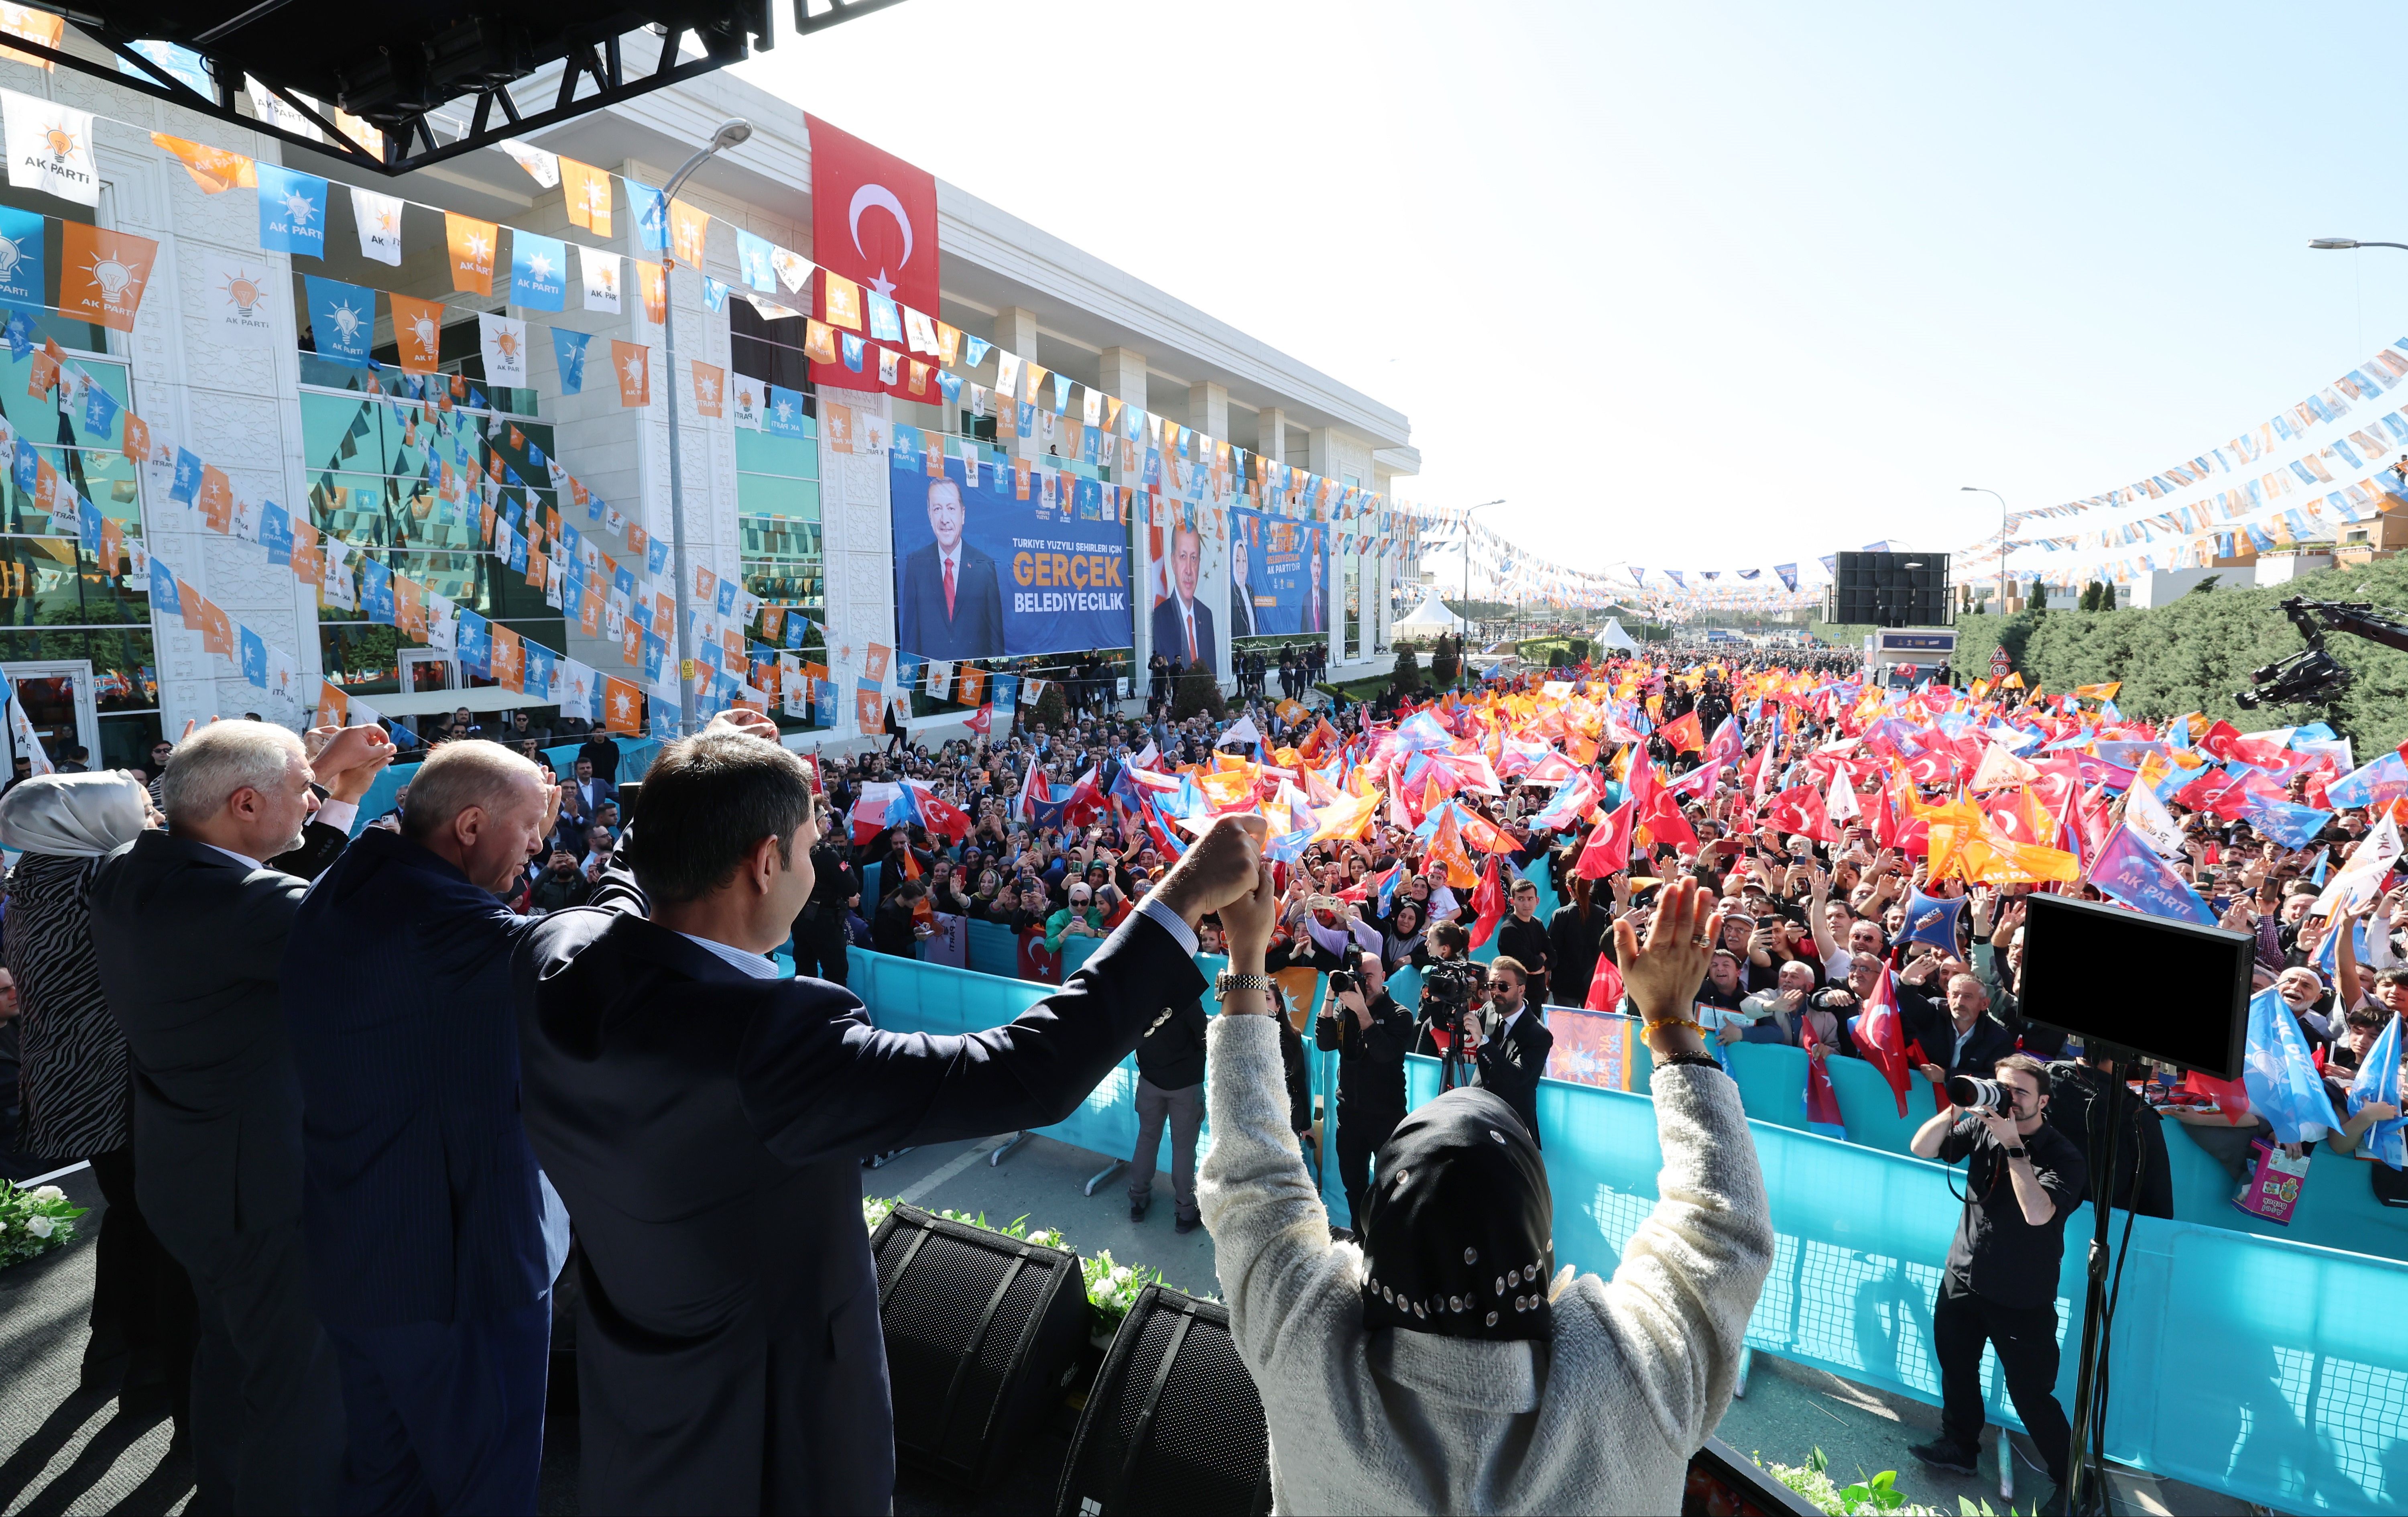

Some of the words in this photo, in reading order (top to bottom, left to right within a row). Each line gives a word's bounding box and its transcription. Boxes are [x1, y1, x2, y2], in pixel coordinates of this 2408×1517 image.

[258, 99, 273, 109] AK
[364, 138, 383, 148] PAR
[25, 156, 46, 169] AK
[195, 159, 212, 171] AK
[269, 222, 287, 233] AK
[372, 235, 384, 246] AK
[460, 262, 474, 271] AK
[476, 264, 490, 275] PAR
[518, 279, 530, 287] AK
[606, 291, 618, 301] PAR
[81, 298, 100, 308] AK
[1013, 552, 1123, 591] GERÇEK
[1267, 566, 1274, 574] AK
[1015, 593, 1125, 613] BELEDİYECİLİK
[1040, 807, 1056, 821] SADECE
[1434, 841, 1445, 854] AK
[1982, 873, 2007, 881] AK
[2117, 871, 2144, 889] AK
[2263, 1197, 2287, 1210] Bebek
[2262, 1205, 2283, 1216] Asel
